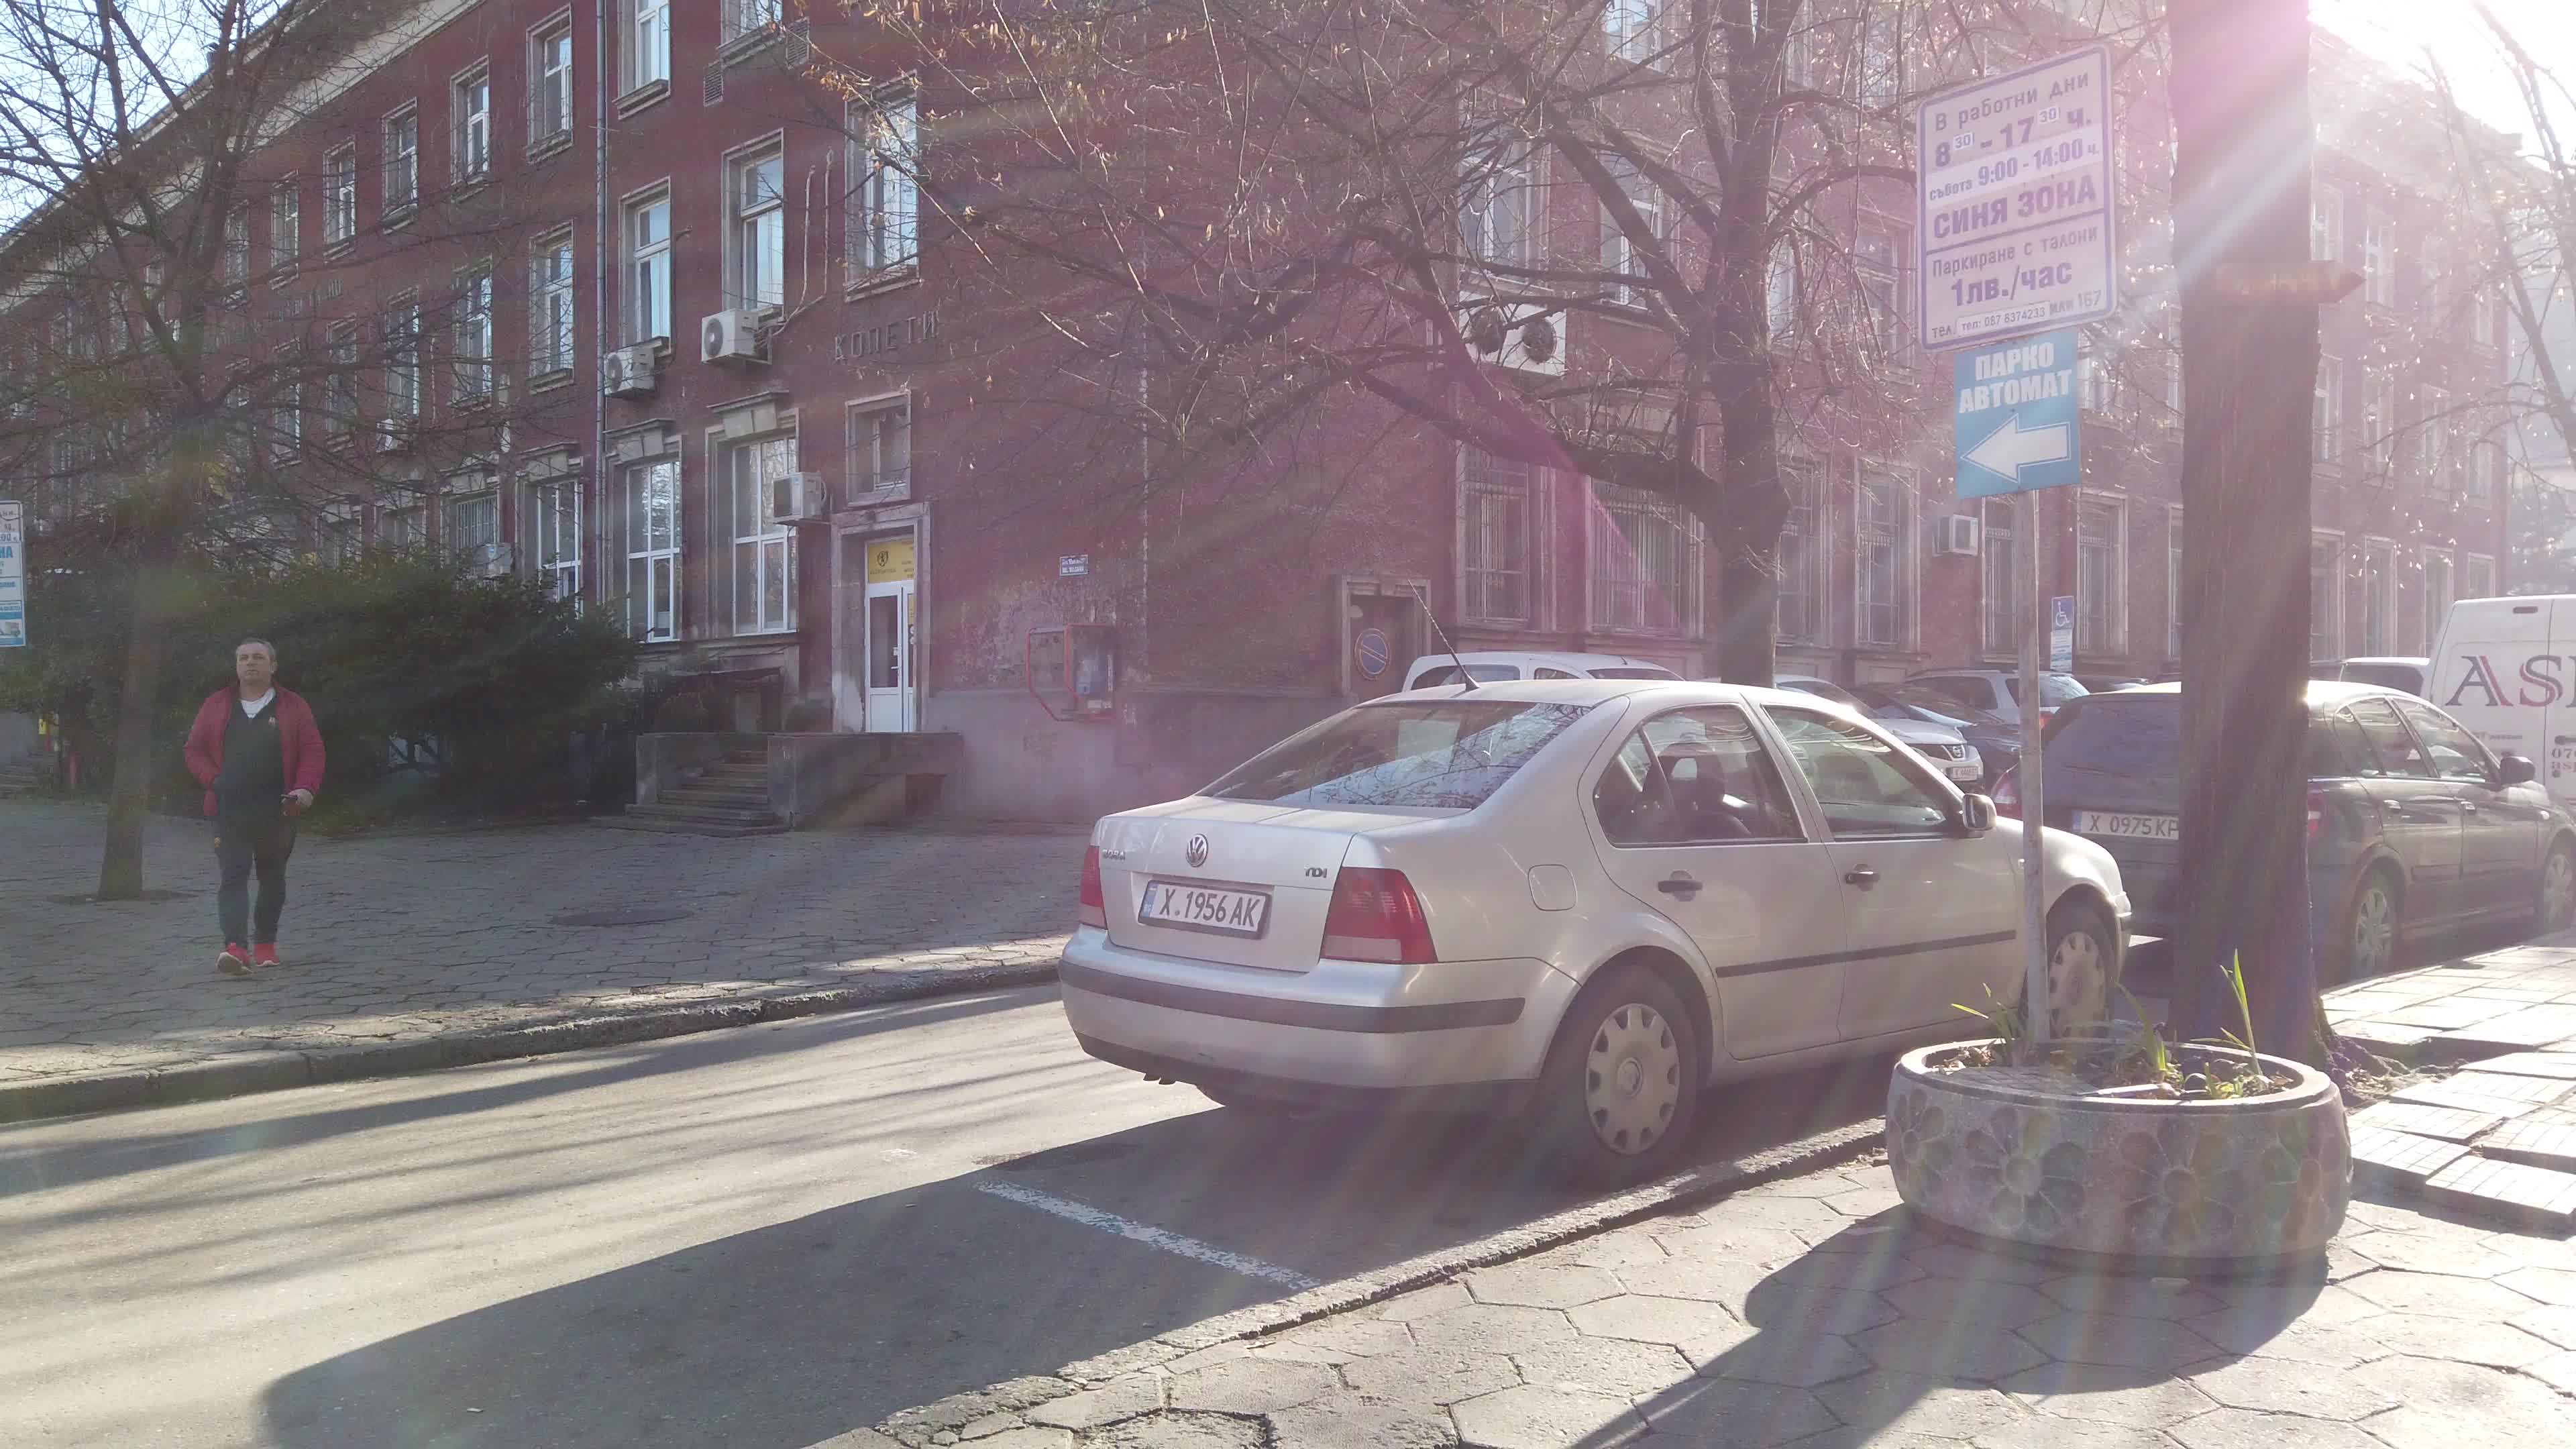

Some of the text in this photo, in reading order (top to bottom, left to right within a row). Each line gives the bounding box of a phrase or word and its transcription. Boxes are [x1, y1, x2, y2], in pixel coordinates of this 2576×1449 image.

[1935, 72, 2089, 131] В работни дни
[1929, 179, 1973, 201] събота
[1978, 157, 2018, 186] 9:00
[2033, 138, 2083, 169] 14:00
[1934, 174, 2096, 239] СИНЯ ЗОНА
[1932, 227, 2099, 278] Паркиране с талони
[1984, 313, 2000, 327] 087
[2004, 307, 2045, 323] 8374233
[1975, 342, 2055, 381] ПАРКО
[1959, 369, 2072, 414] АВТОМАТ
[2445, 654, 2576, 708] AS
[2110, 815, 2152, 836] 0975
